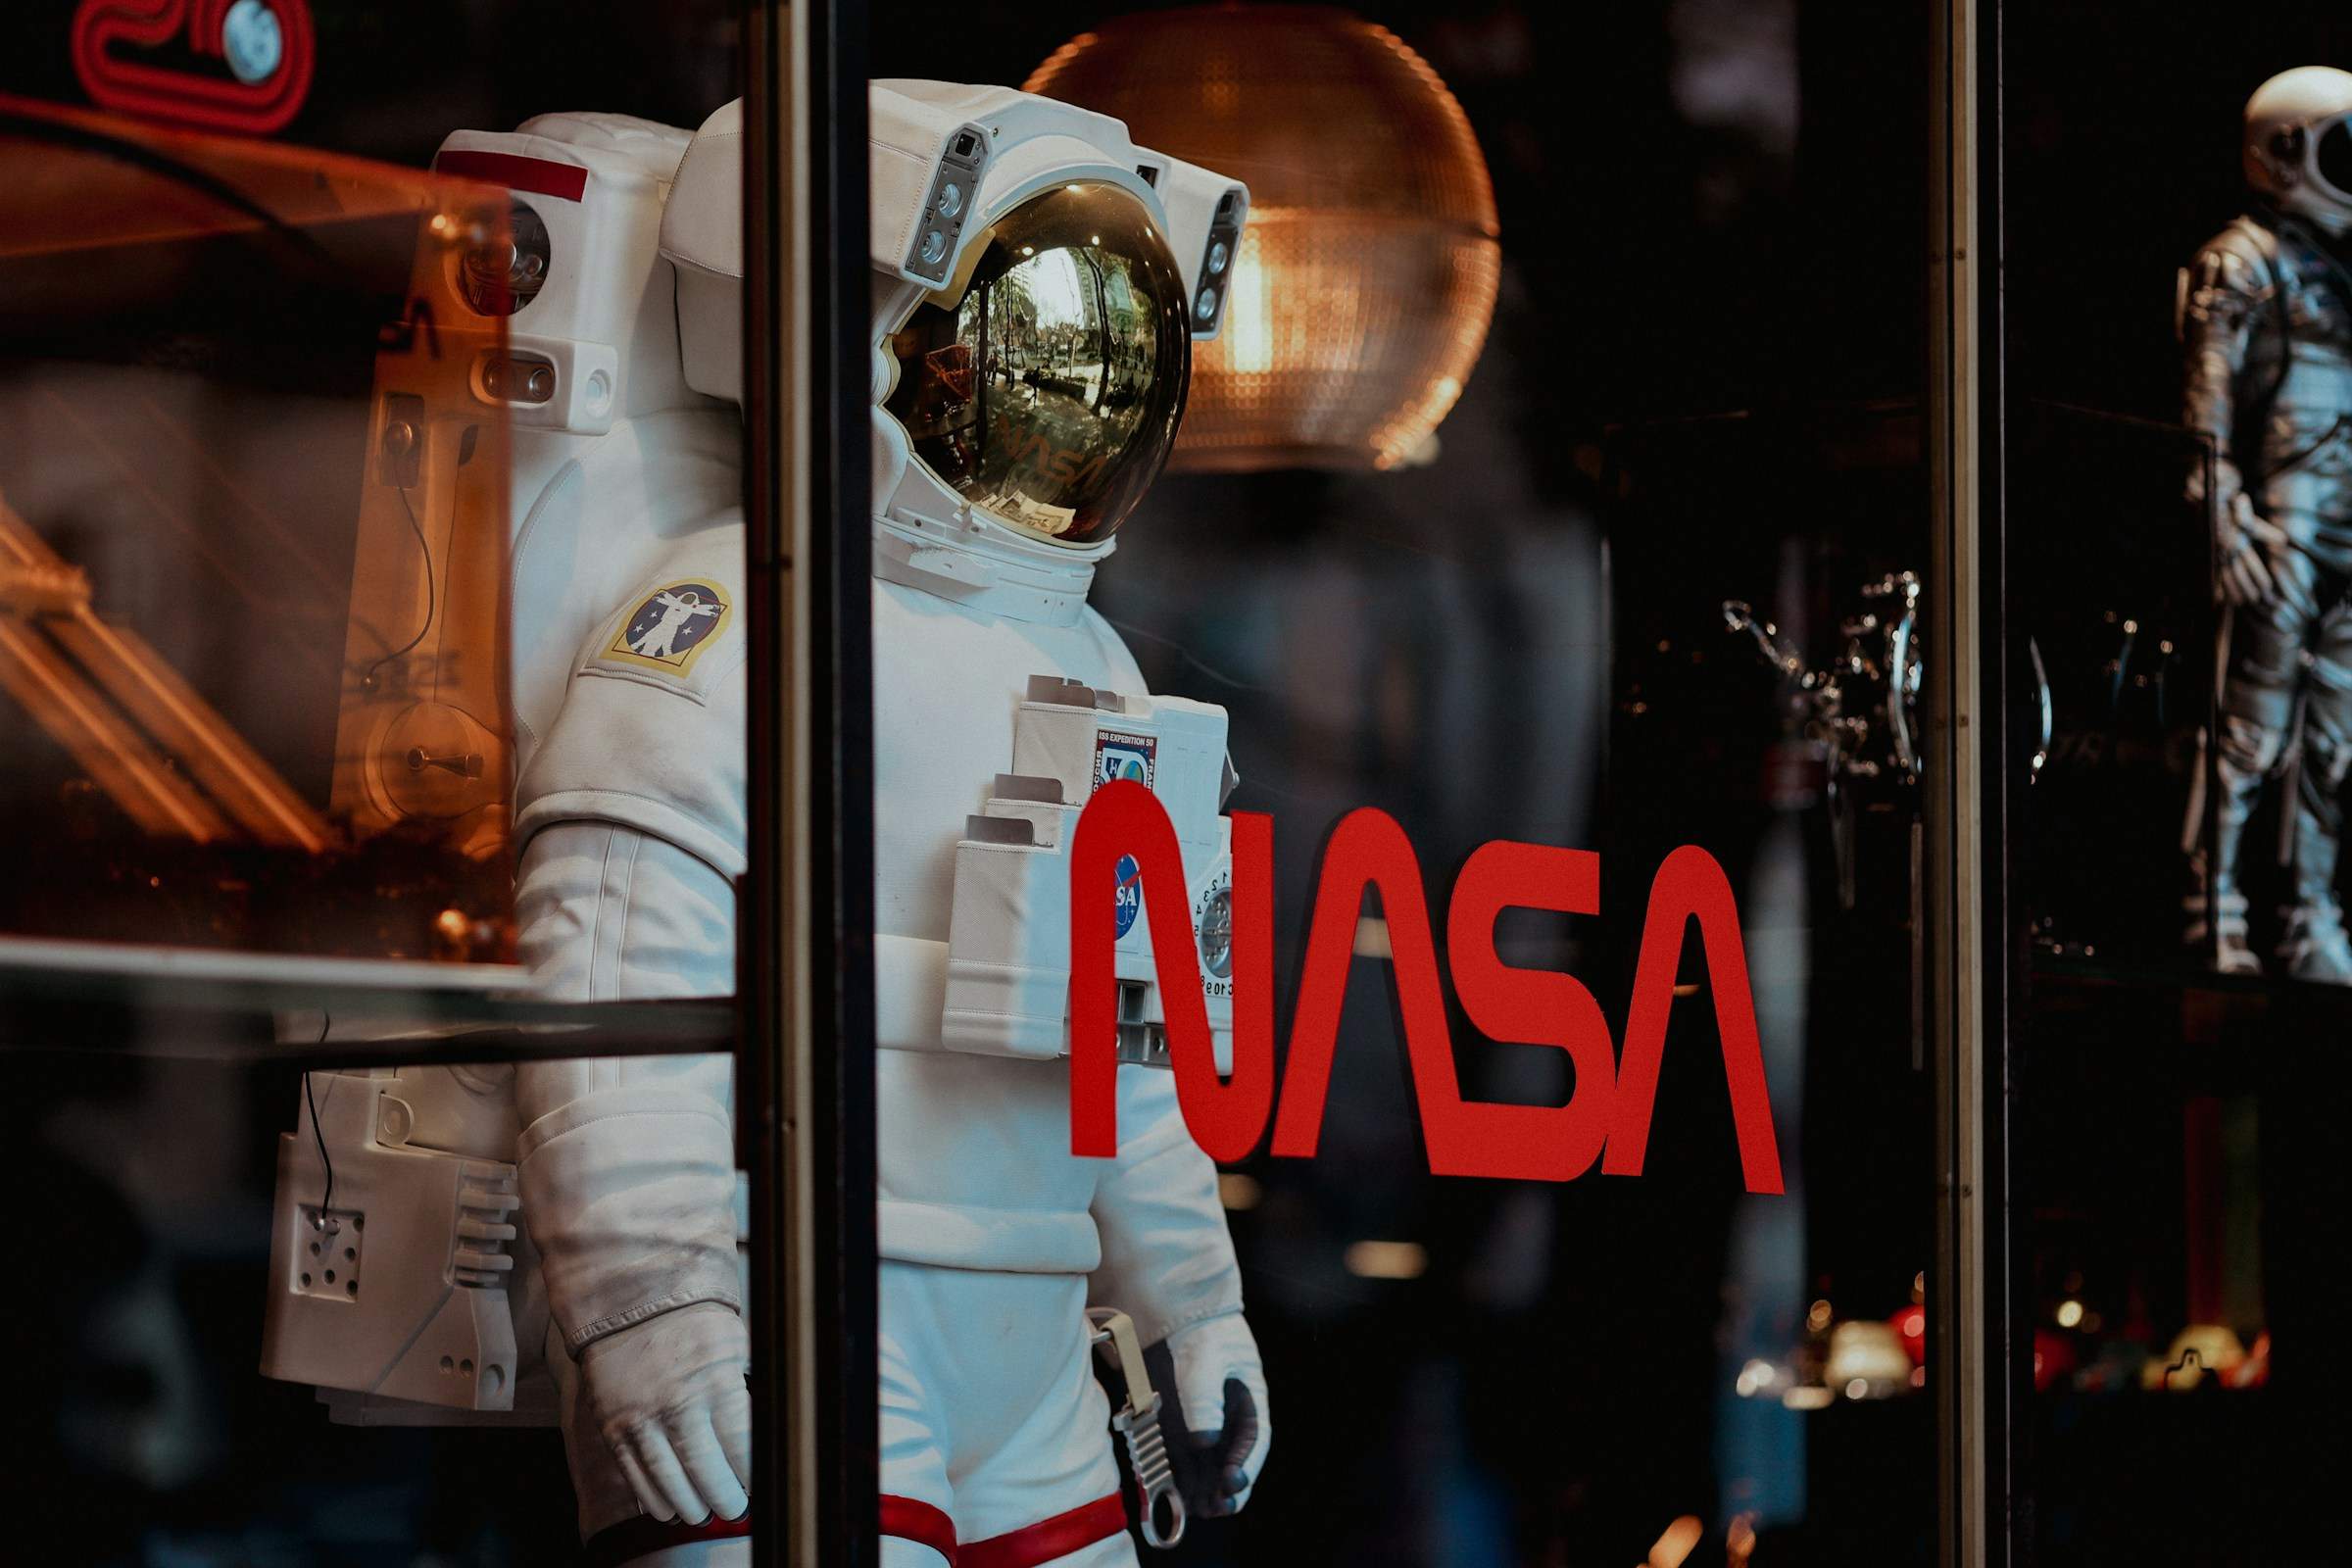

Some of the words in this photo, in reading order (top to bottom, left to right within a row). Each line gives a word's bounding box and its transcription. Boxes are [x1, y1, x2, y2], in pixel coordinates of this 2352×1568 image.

[996, 415, 1108, 489] NASA
[1099, 731, 1109, 740] ISS
[1109, 734, 1145, 746] EXPEDITION
[1146, 738, 1153, 747] 50
[1093, 751, 1102, 793] ОССИЯ
[1115, 886, 1138, 906] SA
[1070, 778, 1786, 1196] NASA
